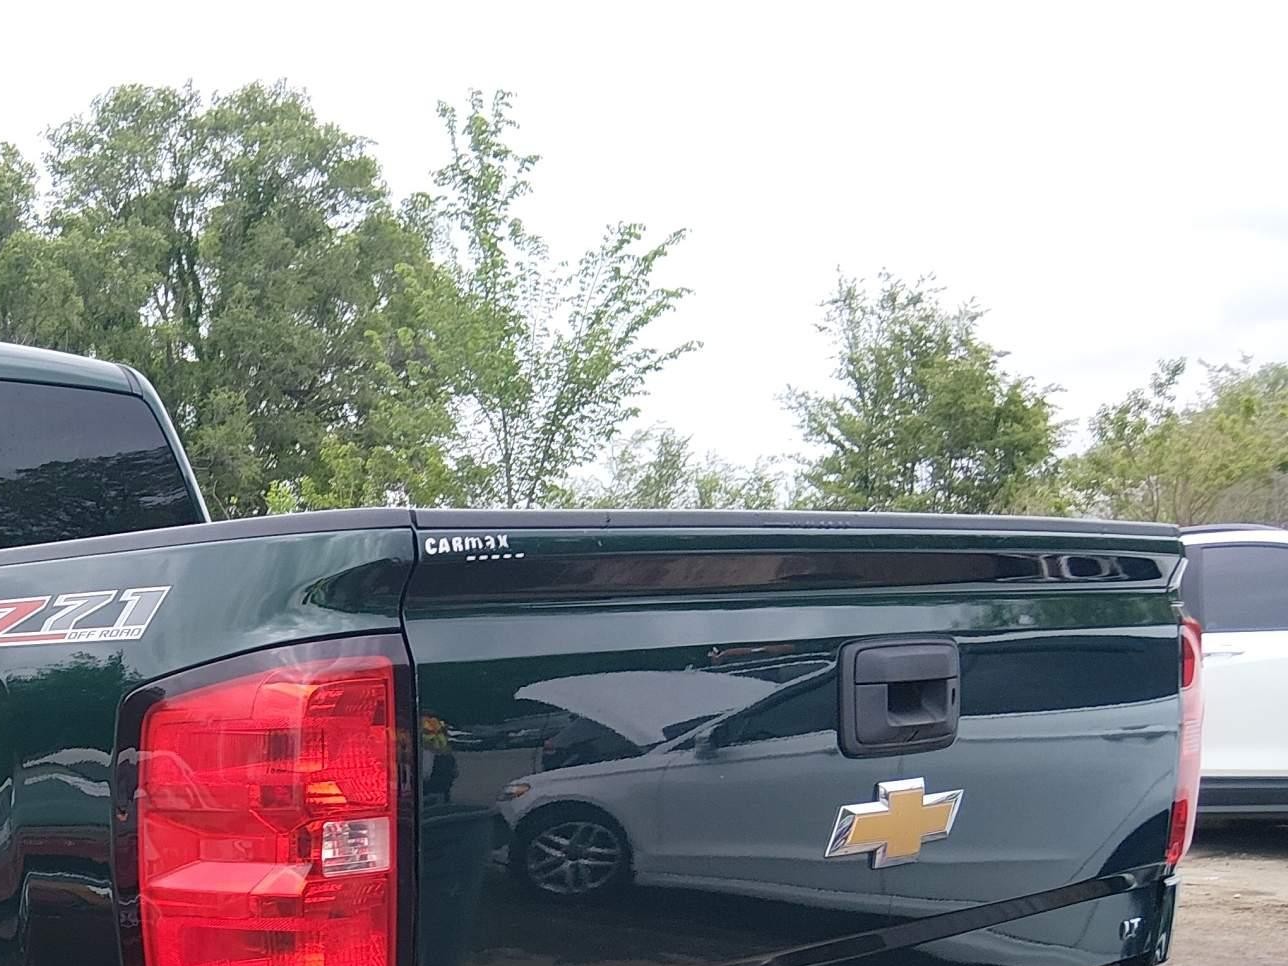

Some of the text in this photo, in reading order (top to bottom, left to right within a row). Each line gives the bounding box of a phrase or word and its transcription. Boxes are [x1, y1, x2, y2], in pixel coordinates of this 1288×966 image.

[67, 627, 143, 640] OFF ROAD
[1122, 917, 1142, 940] LT
